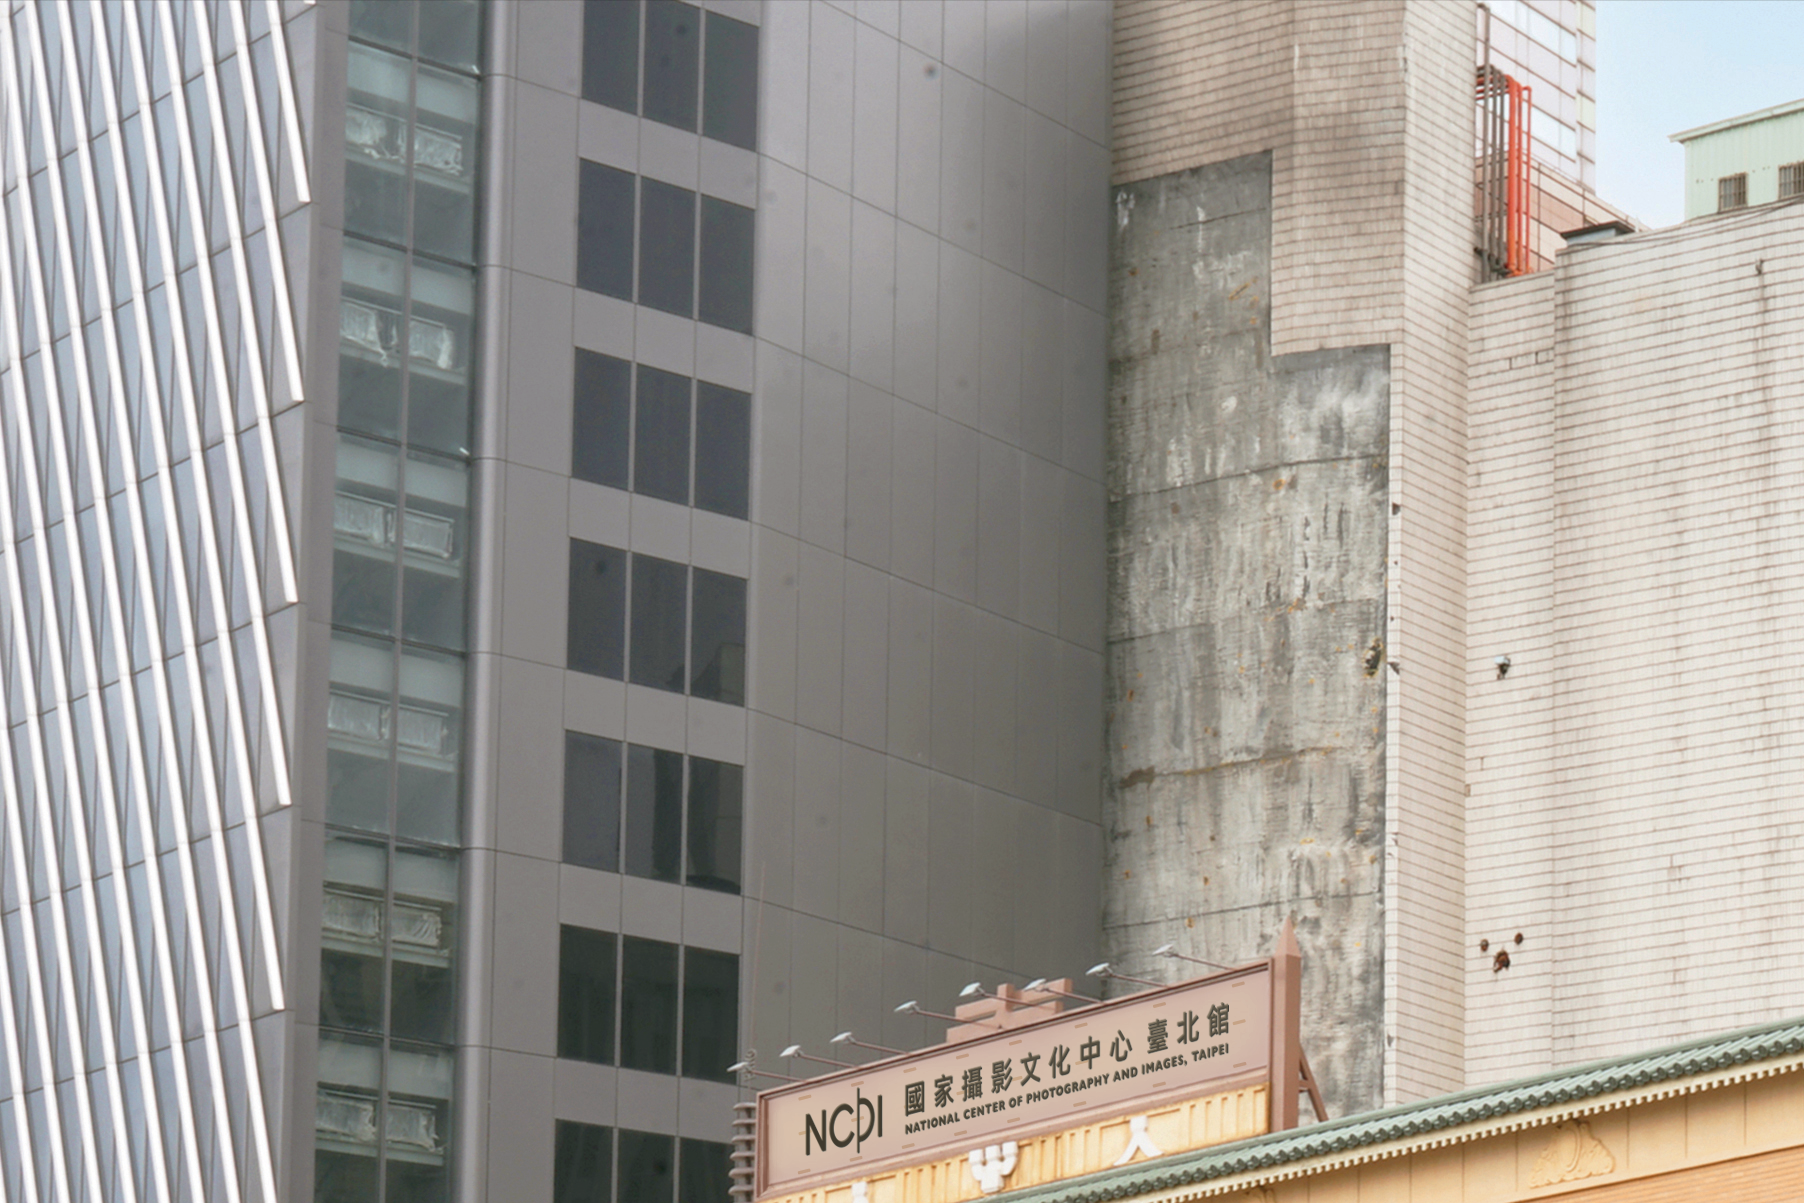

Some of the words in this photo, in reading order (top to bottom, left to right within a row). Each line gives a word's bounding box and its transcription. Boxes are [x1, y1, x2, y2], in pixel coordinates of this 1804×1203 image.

[905, 1029, 1133, 1117] 國家攝影文化中心
[1147, 1002, 1230, 1055] 臺北館
[905, 1111, 960, 1135] NATIONAL
[963, 1099, 1006, 1120] CENTER
[1008, 1095, 1024, 1109] OF
[1026, 1073, 1110, 1105] PHOTOGRAPHY
[1113, 1066, 1139, 1083] AND
[1141, 1055, 1188, 1075] IMAGES,
[1191, 1043, 1230, 1063] TAIPEI
